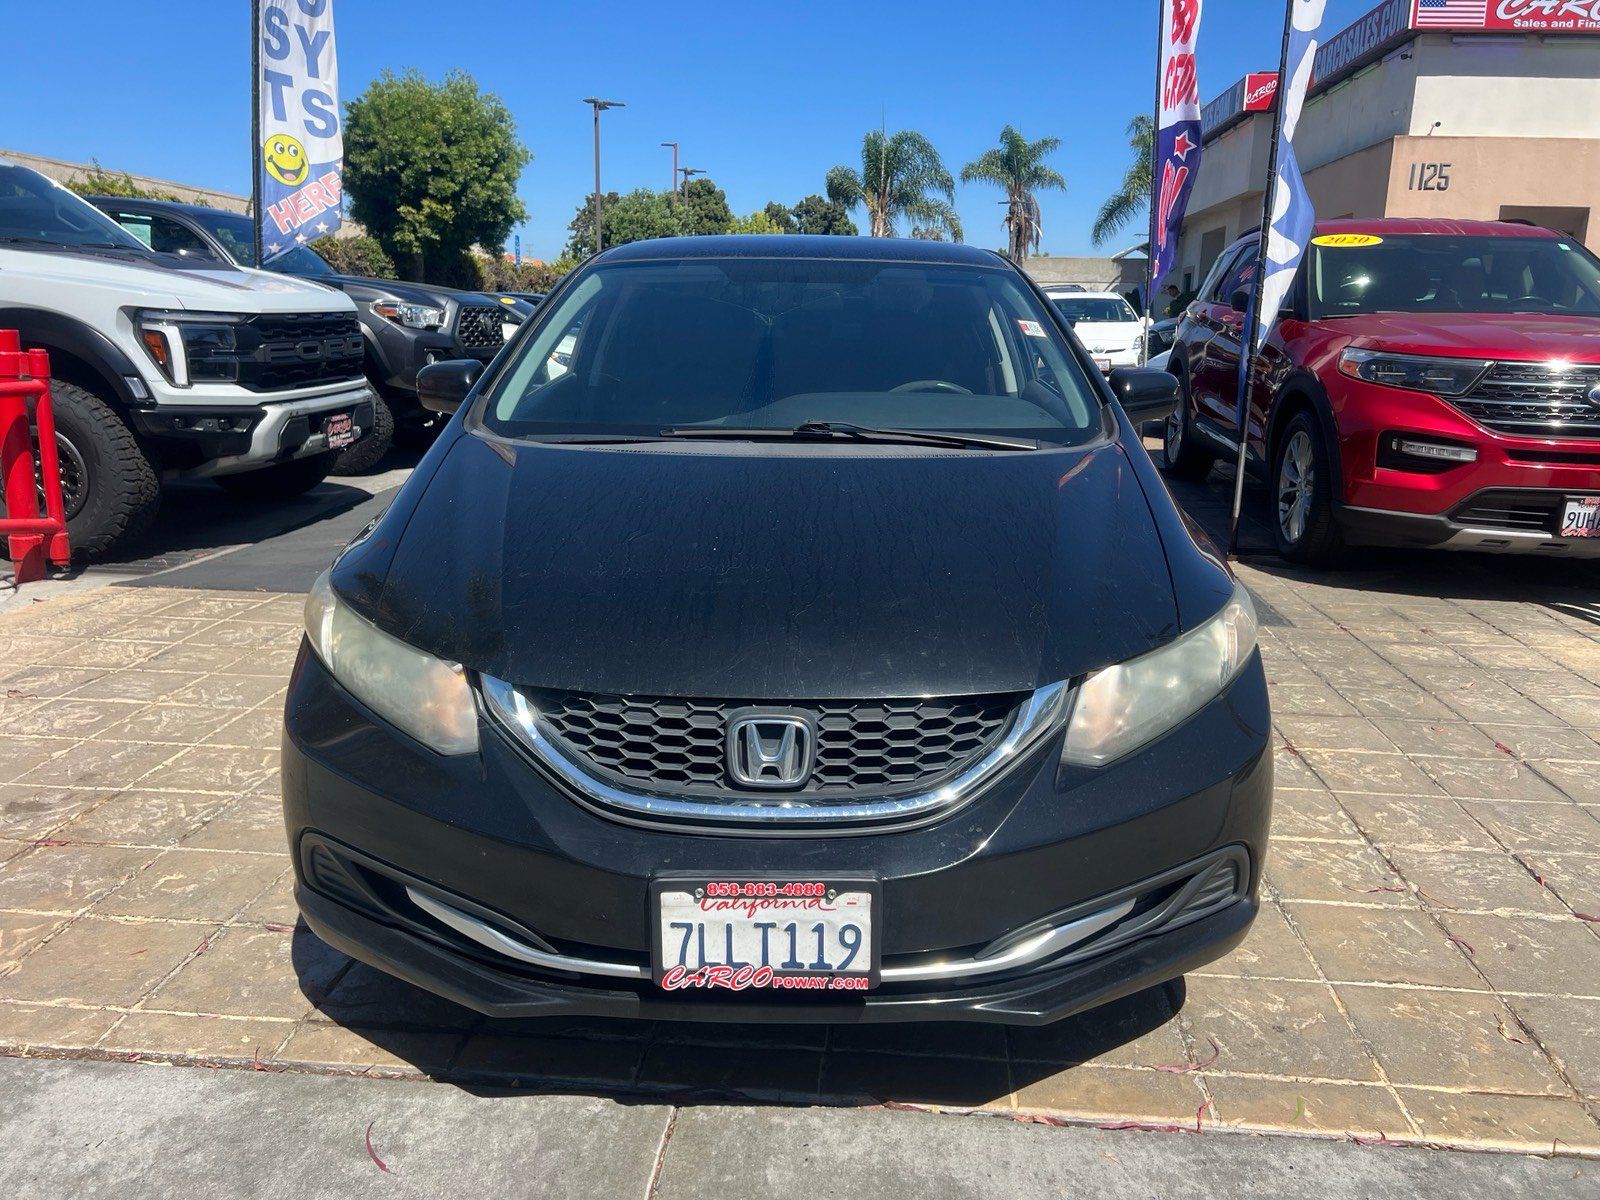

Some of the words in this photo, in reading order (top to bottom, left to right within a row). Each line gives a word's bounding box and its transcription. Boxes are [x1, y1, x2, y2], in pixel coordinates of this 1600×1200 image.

[1513, 19, 1547, 28] Sales
[1550, 19, 1574, 28] and
[1246, 80, 1278, 104] CARCO
[1409, 162, 1452, 191] 1125
[1323, 236, 1370, 244] 2020
[1566, 511, 1600, 529] 9UH
[707, 882, 825, 897] 858-883-4888
[700, 896, 837, 918] California
[669, 922, 863, 971] 7LLT119
[662, 965, 774, 990] CARCO
